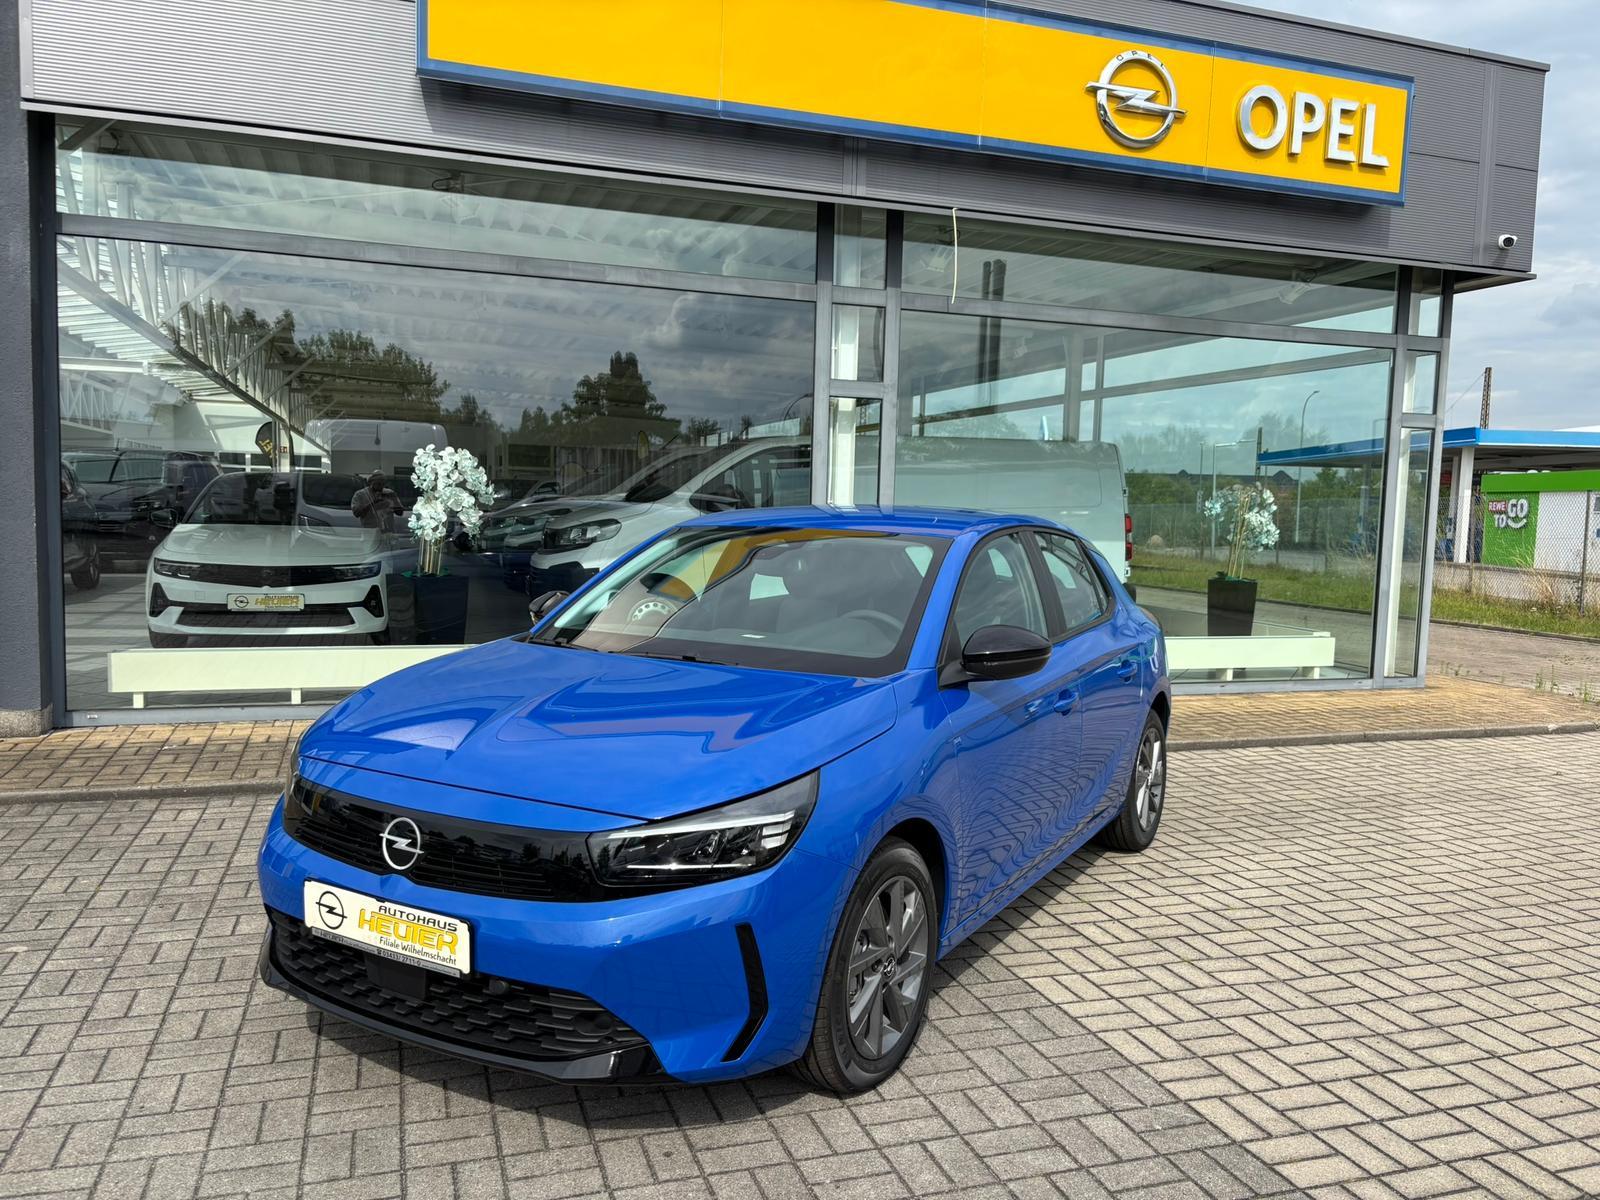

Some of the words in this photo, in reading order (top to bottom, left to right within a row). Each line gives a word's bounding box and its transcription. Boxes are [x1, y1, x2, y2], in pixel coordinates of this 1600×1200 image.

[1238, 85, 1390, 168] OPEL
[1488, 501, 1506, 511] REWE
[1508, 498, 1528, 518] GO
[1494, 514, 1507, 528] TO
[358, 908, 459, 955] HEUTER
[378, 905, 458, 932] AUTOHAUS
[379, 936, 401, 950] Filiale
[401, 942, 457, 966] Wilhelmschacht
